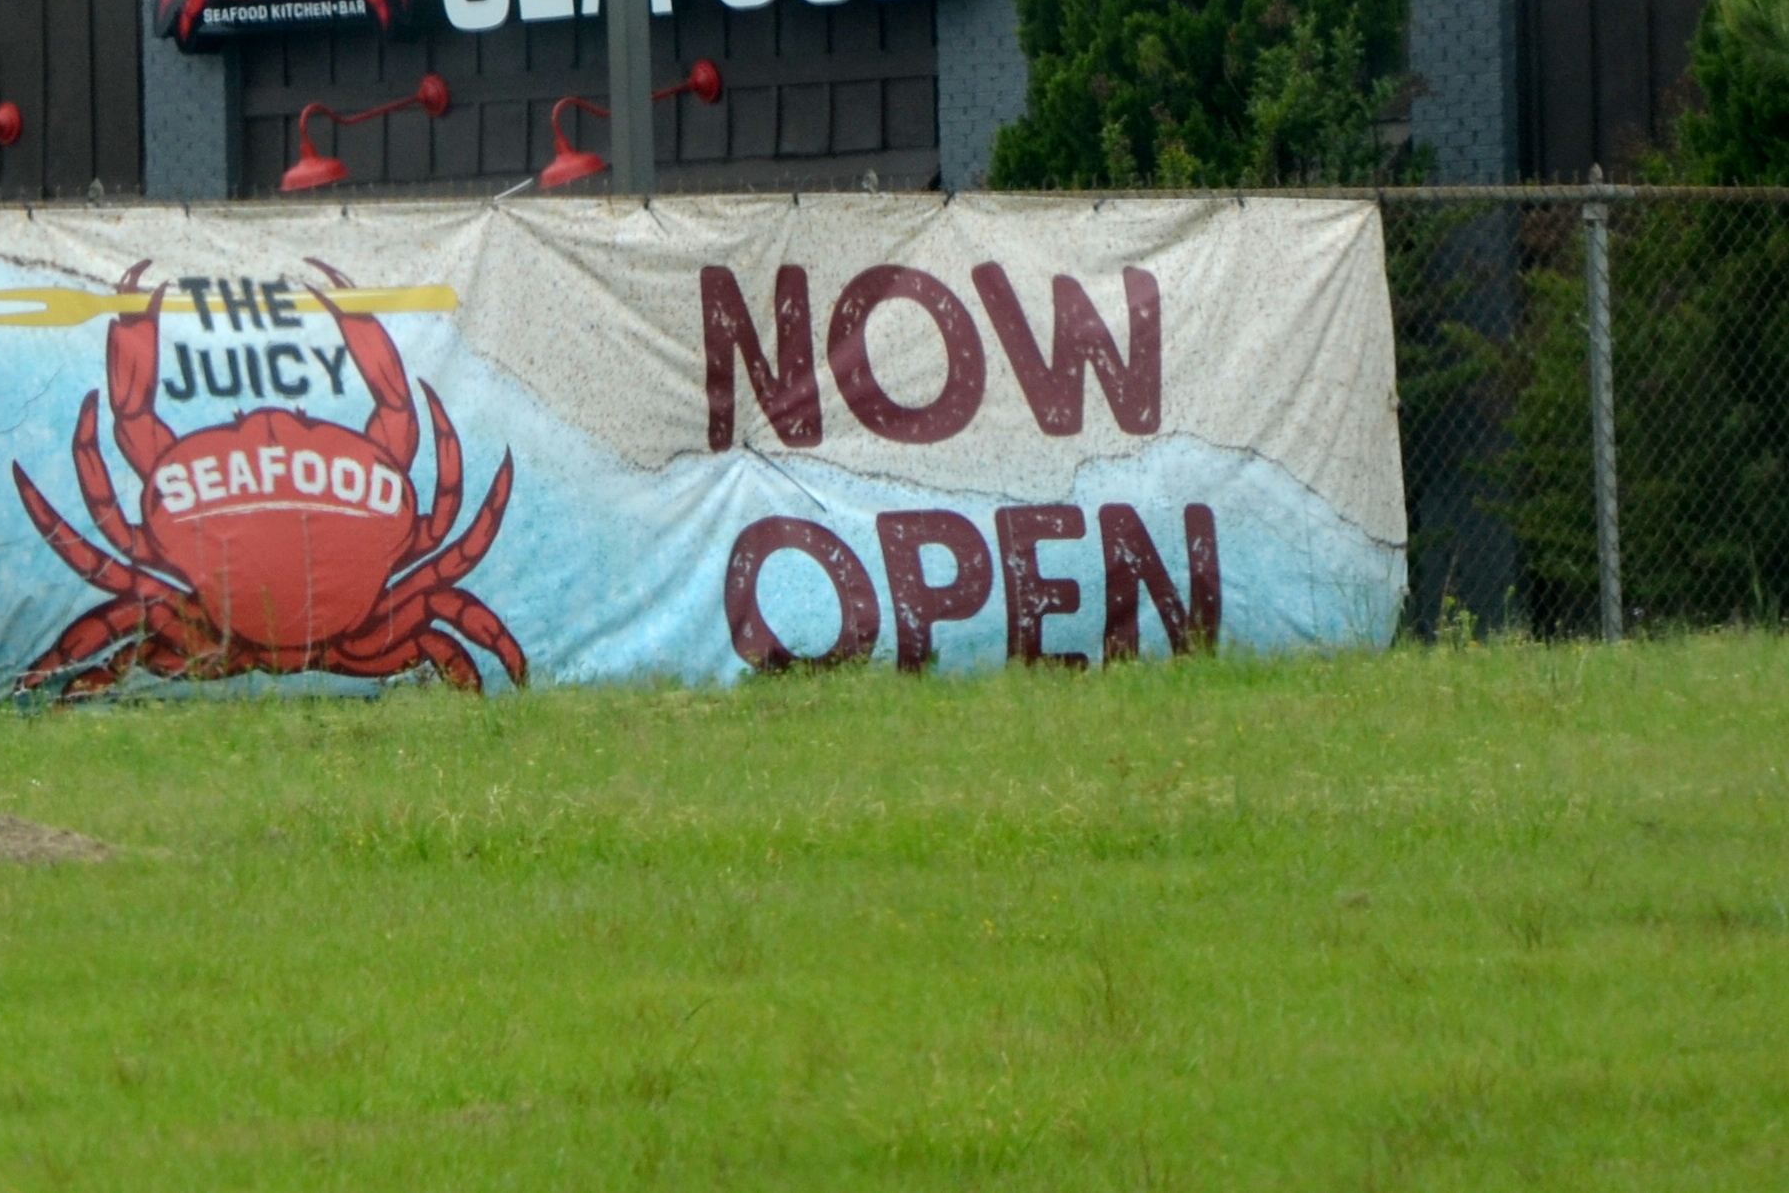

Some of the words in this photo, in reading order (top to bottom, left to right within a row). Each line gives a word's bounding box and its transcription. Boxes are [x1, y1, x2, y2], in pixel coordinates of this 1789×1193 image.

[202, 5, 269, 24] SEAFOOD
[178, 275, 305, 333] THE
[163, 341, 353, 402] JUICY
[699, 260, 1162, 452] NOW
[155, 443, 404, 515] SEAFOOD
[723, 502, 1222, 673] OPEN
